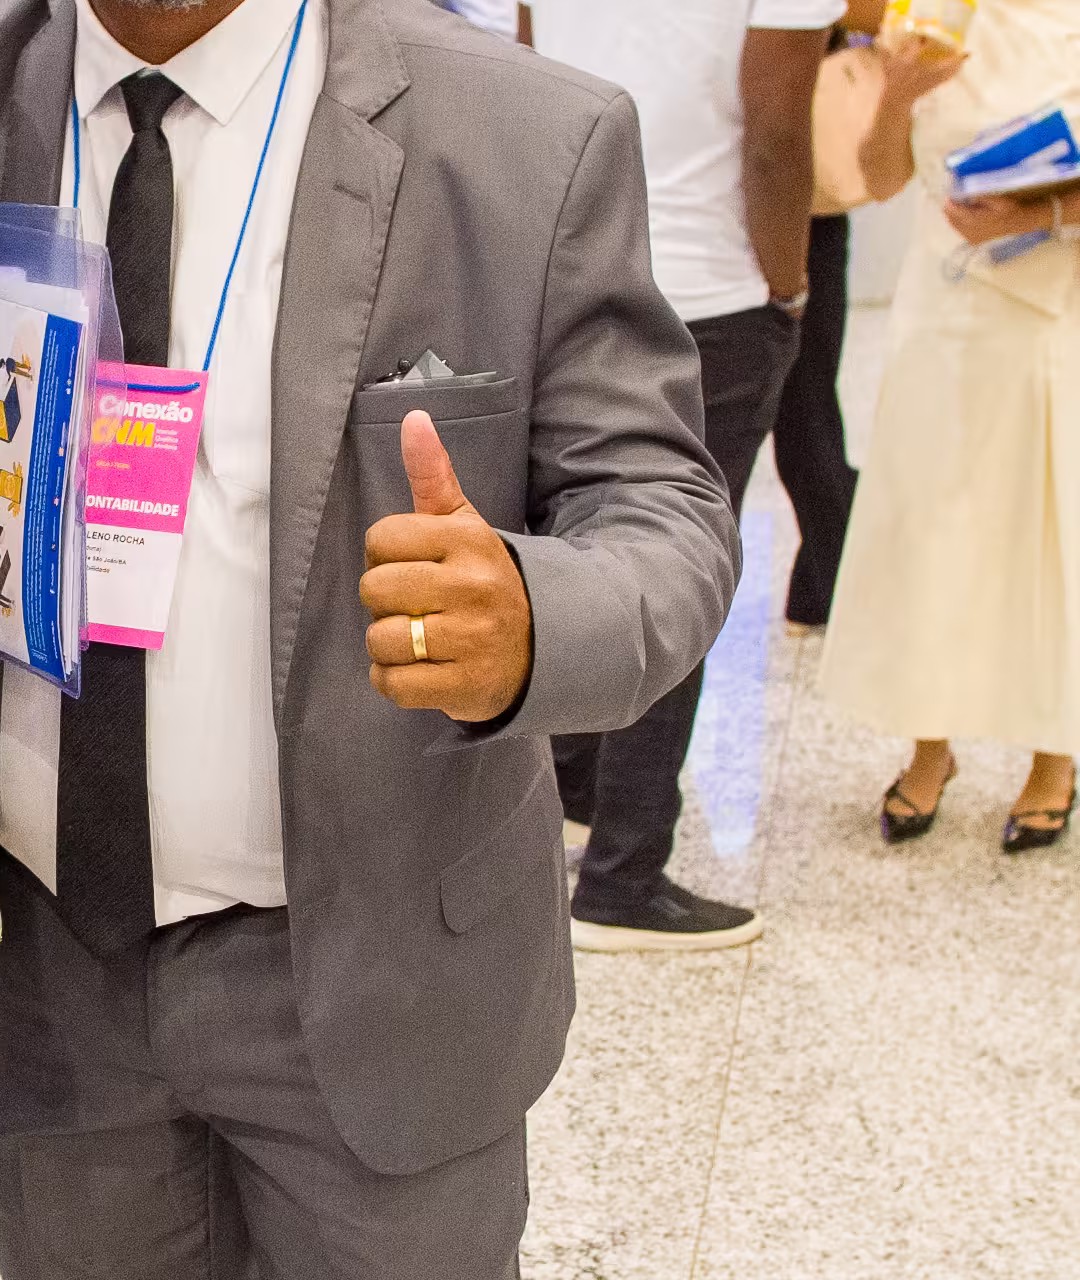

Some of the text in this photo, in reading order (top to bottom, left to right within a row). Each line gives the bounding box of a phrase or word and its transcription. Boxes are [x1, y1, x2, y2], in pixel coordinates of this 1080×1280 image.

[99, 394, 194, 423] Conexão
[86, 495, 179, 517] ONTABILIDADE
[86, 531, 145, 545] LENO ROCHA
